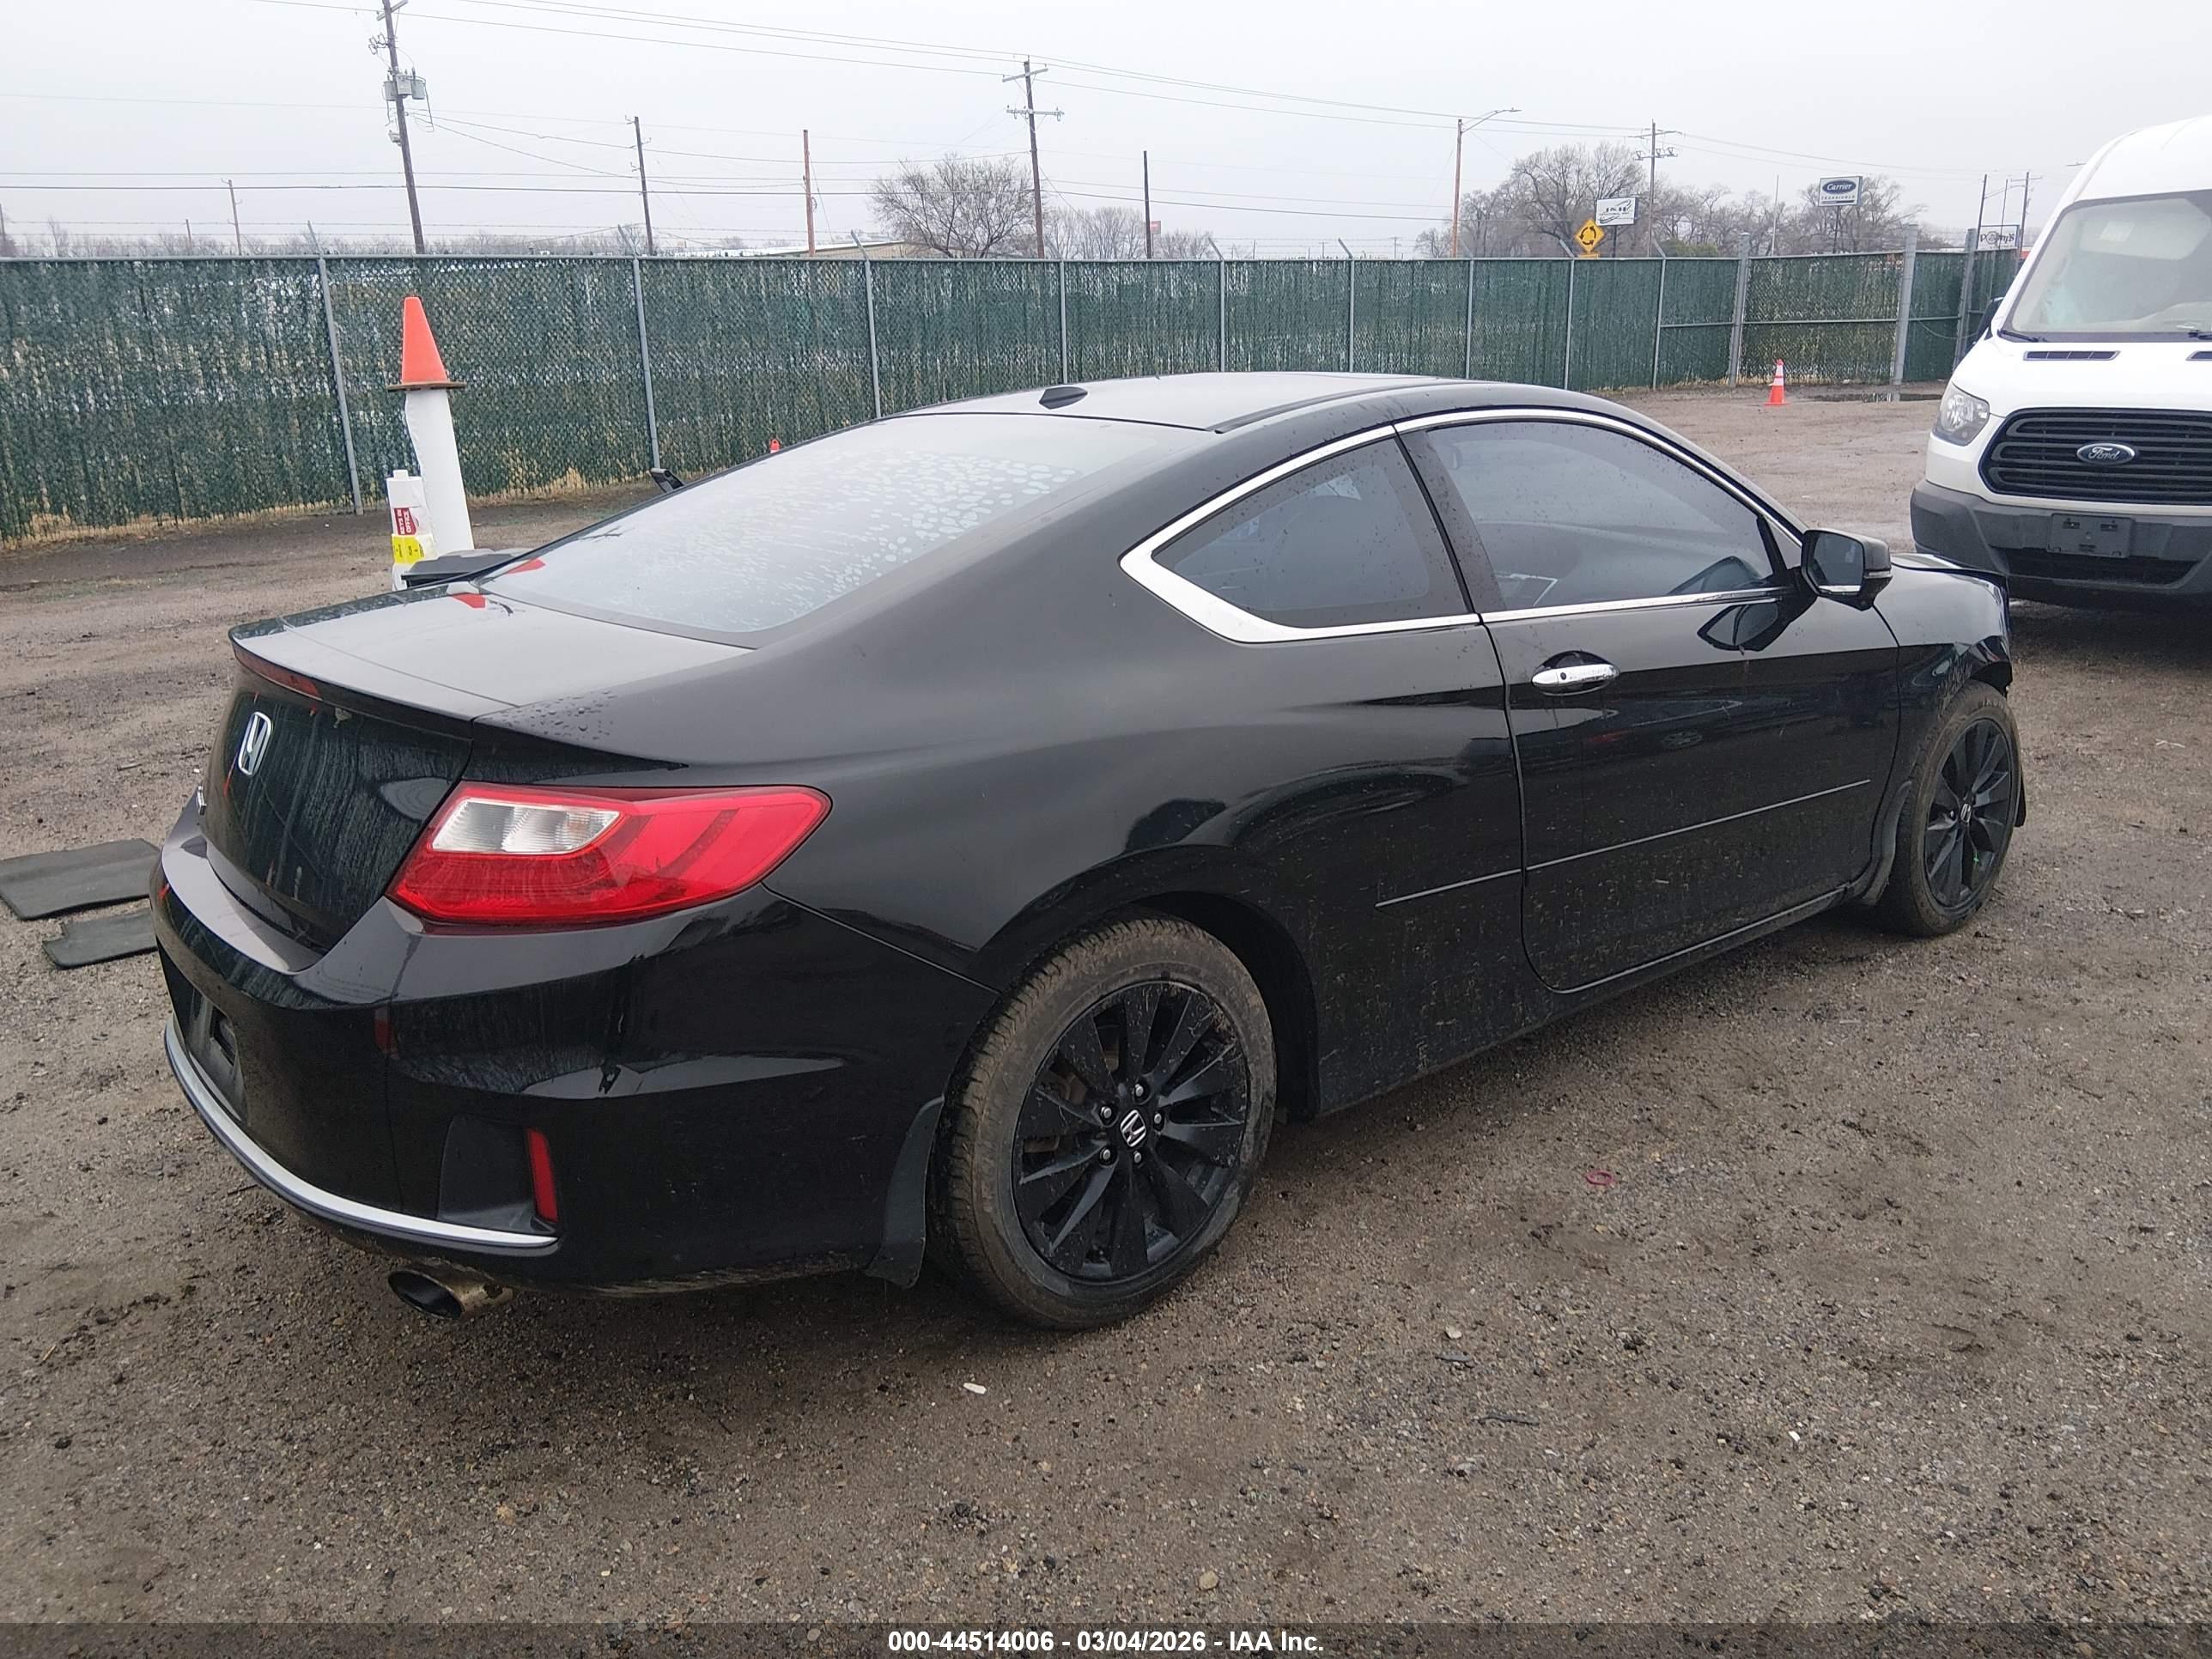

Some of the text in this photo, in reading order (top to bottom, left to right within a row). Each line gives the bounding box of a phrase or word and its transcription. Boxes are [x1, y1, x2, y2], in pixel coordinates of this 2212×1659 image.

[1826, 182, 1853, 191] Carrier
[2087, 447, 2120, 459] Ford
[404, 510, 412, 533] OFFICE
